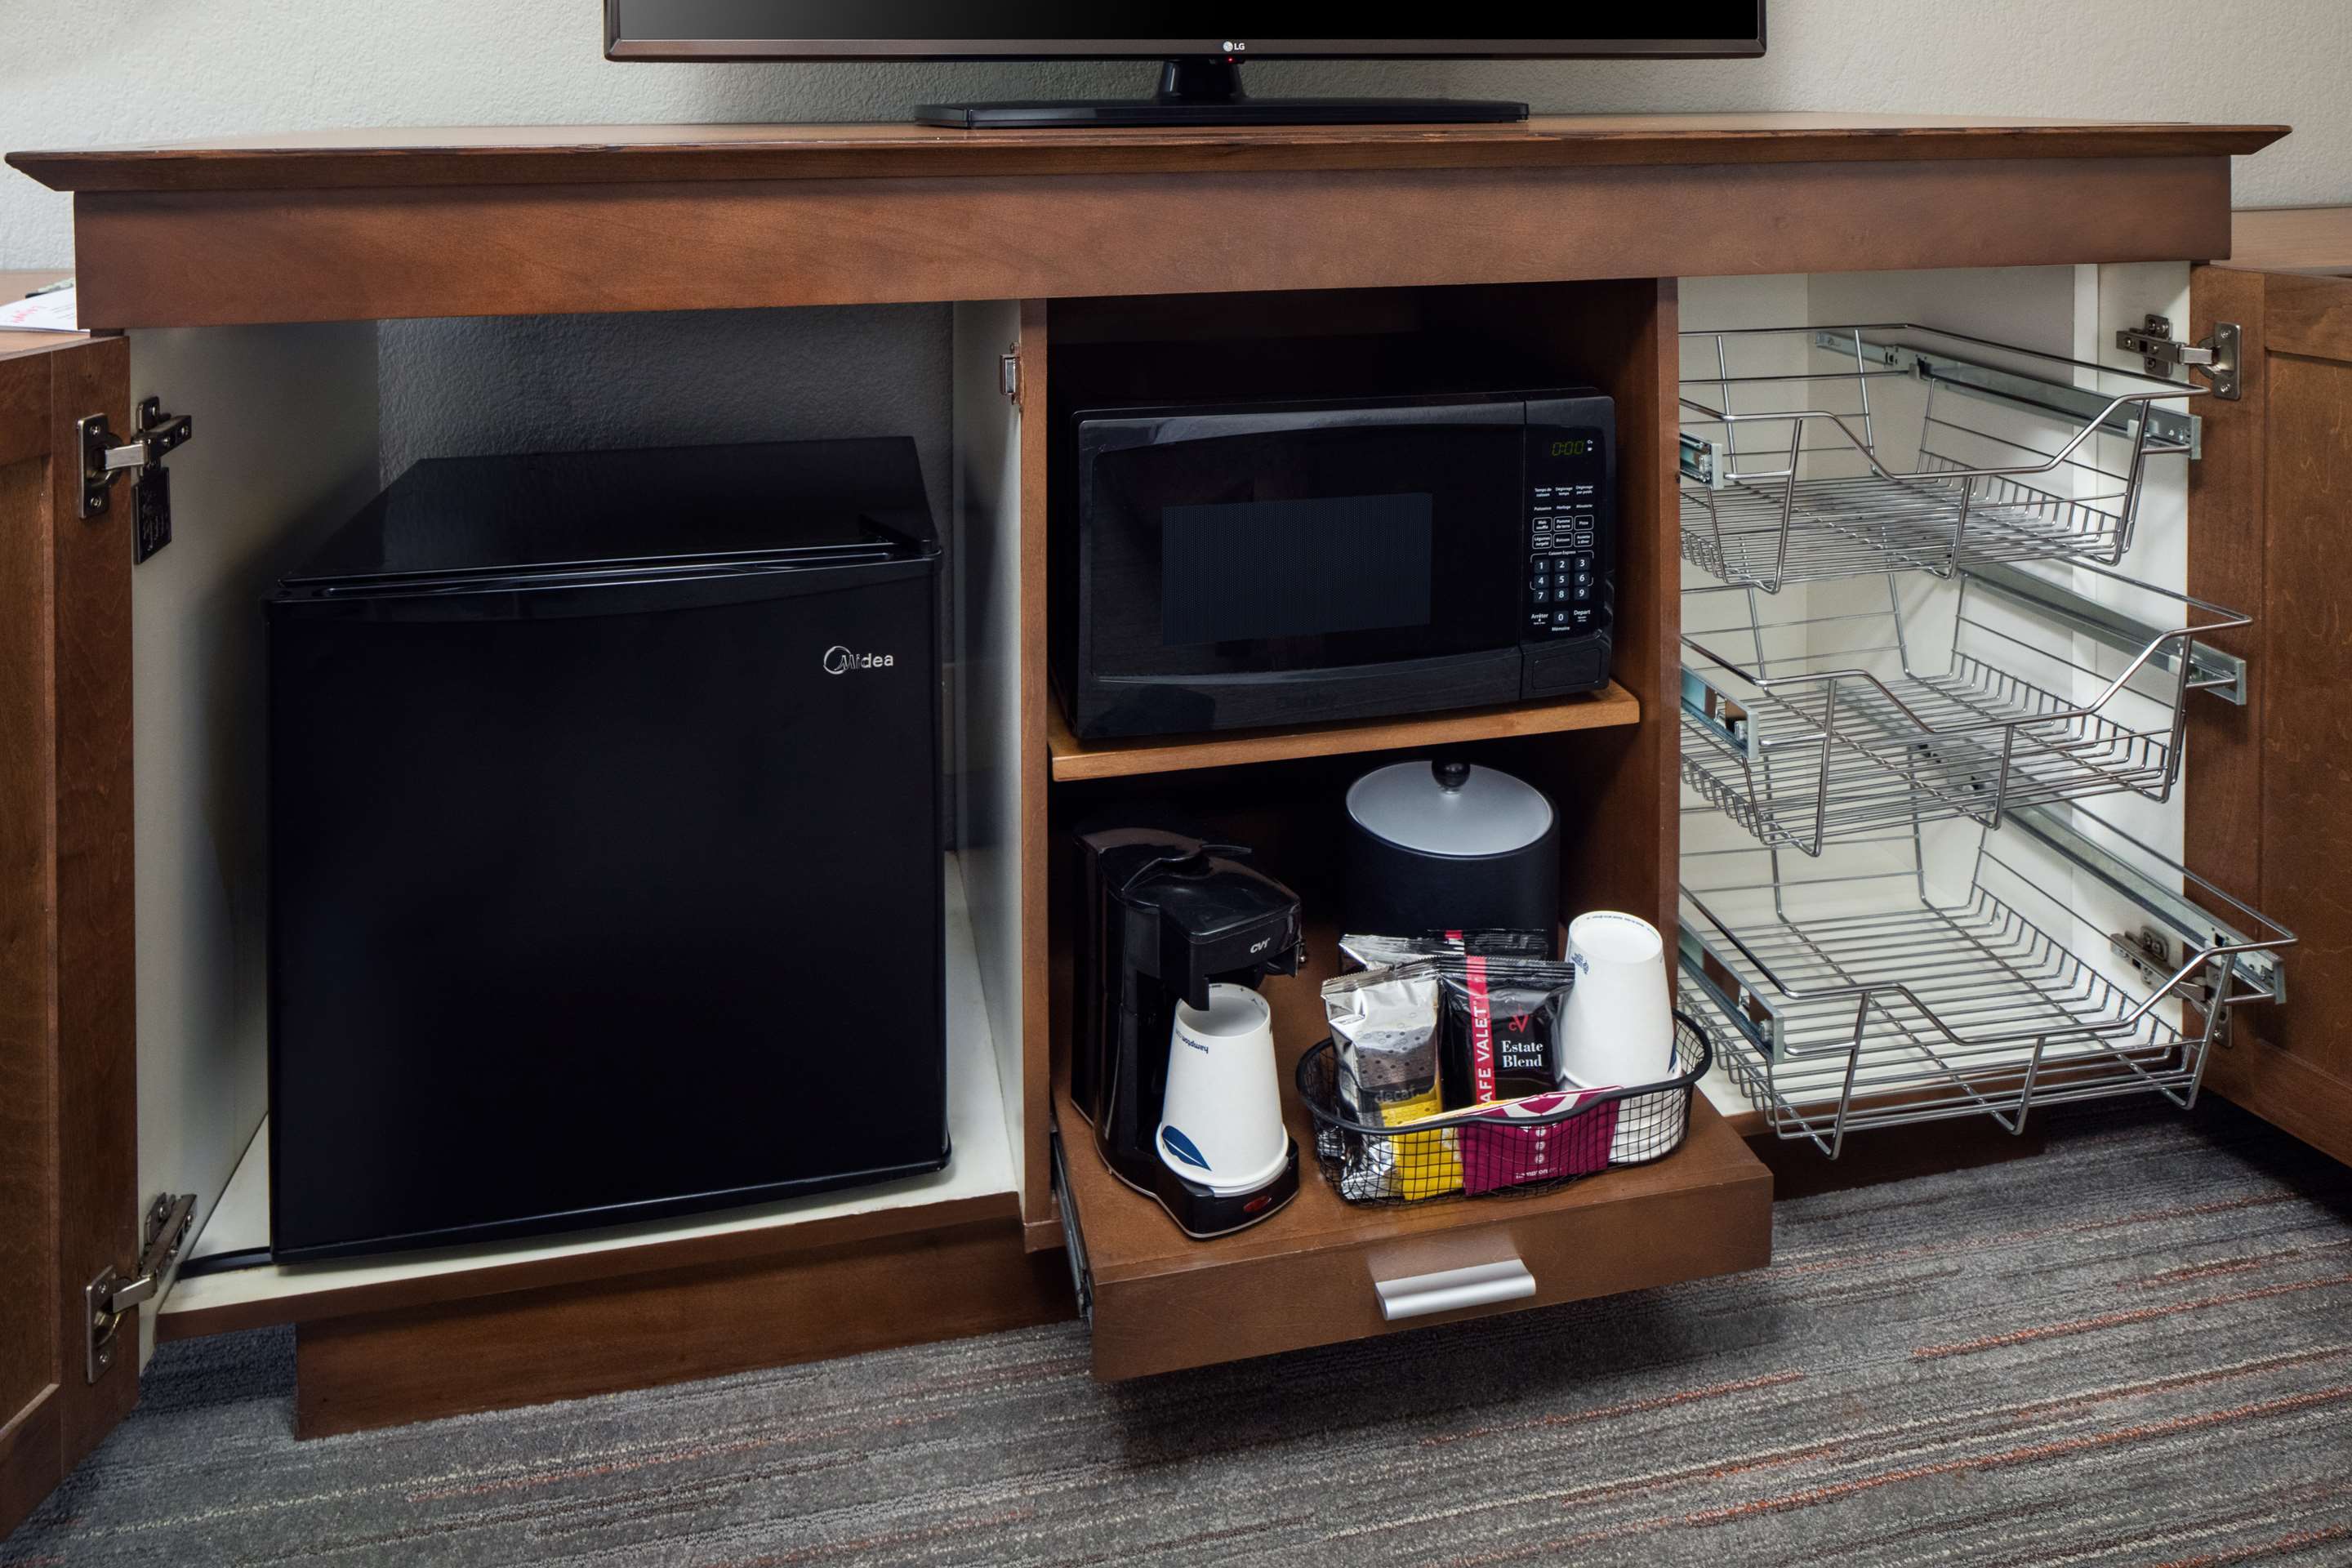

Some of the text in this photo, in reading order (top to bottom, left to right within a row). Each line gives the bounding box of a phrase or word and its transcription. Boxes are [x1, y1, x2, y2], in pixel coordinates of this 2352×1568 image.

[1538, 577, 1544, 585] 4
[1579, 589, 1584, 597] 9
[823, 646, 894, 675] Midea
[1501, 1040, 1544, 1053] Estate
[1473, 1004, 1493, 1103] AFE VALET
[1503, 1054, 1543, 1068] Blend
